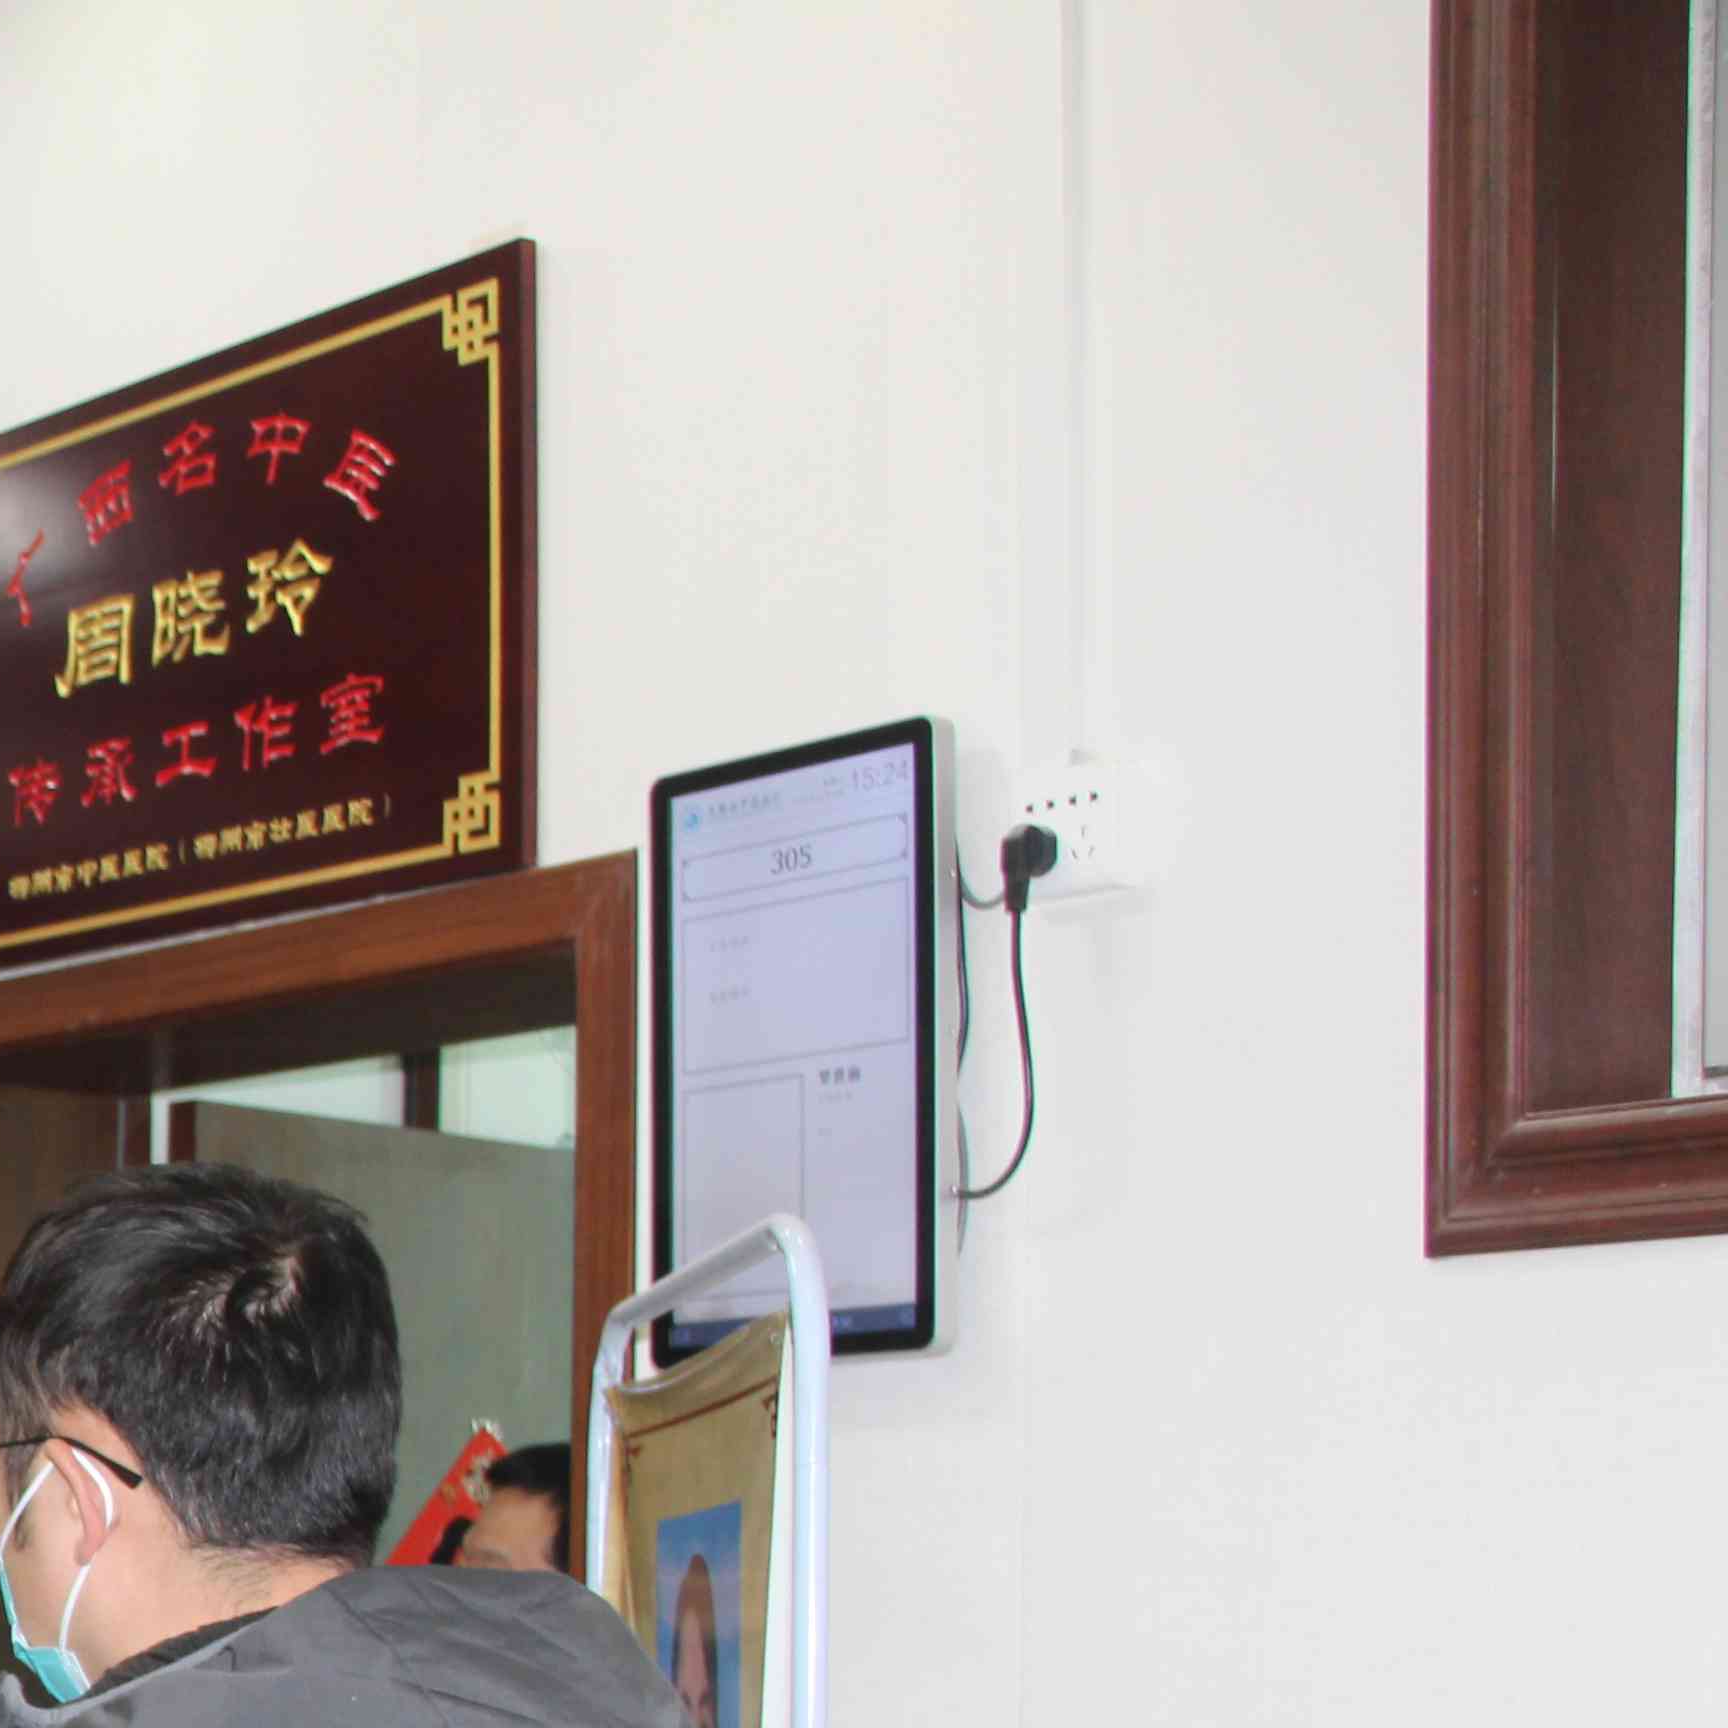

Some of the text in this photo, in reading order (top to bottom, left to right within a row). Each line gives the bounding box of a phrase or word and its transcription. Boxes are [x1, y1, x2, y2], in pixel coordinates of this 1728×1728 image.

[54, 537, 334, 699] 周晓玲
[7, 672, 385, 827] 传承工作室
[770, 844, 813, 875] 305
